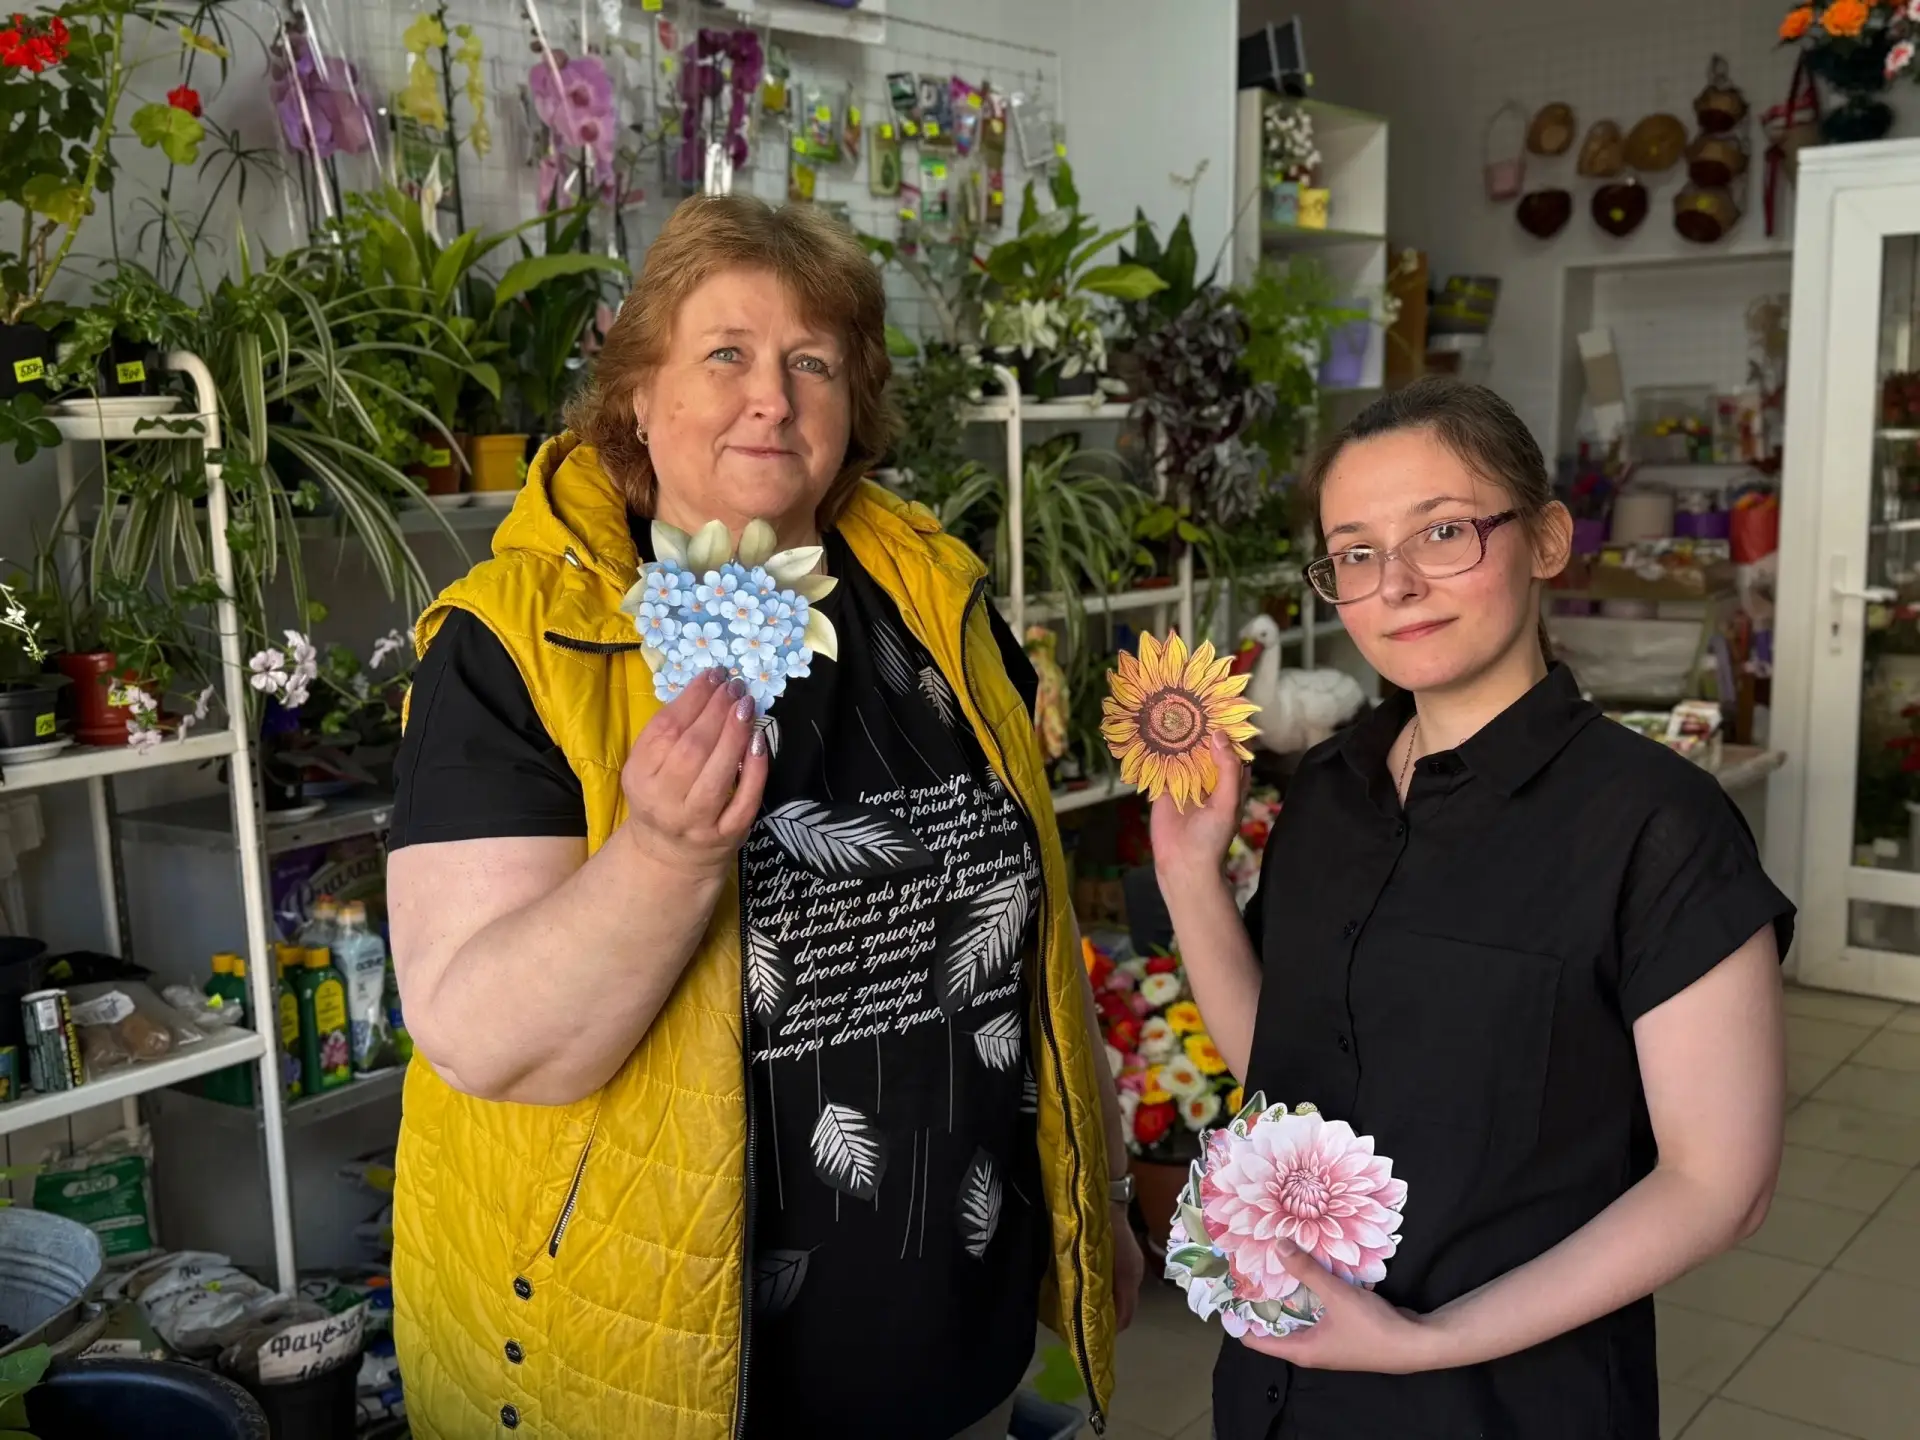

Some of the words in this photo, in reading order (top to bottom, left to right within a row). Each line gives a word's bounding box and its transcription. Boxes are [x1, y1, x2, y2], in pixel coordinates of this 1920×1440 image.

[866, 881, 895, 905] ads
[793, 936, 856, 966] drooei
[860, 917, 936, 955] xpuoips
[795, 955, 860, 986] drooei
[862, 936, 937, 975] xpuoips
[779, 1007, 845, 1037] drooei
[847, 988, 923, 1025] xpuoips
[786, 987, 850, 1017] drooei
[853, 967, 929, 1005] xpuoips
[830, 1015, 890, 1047] drooei
